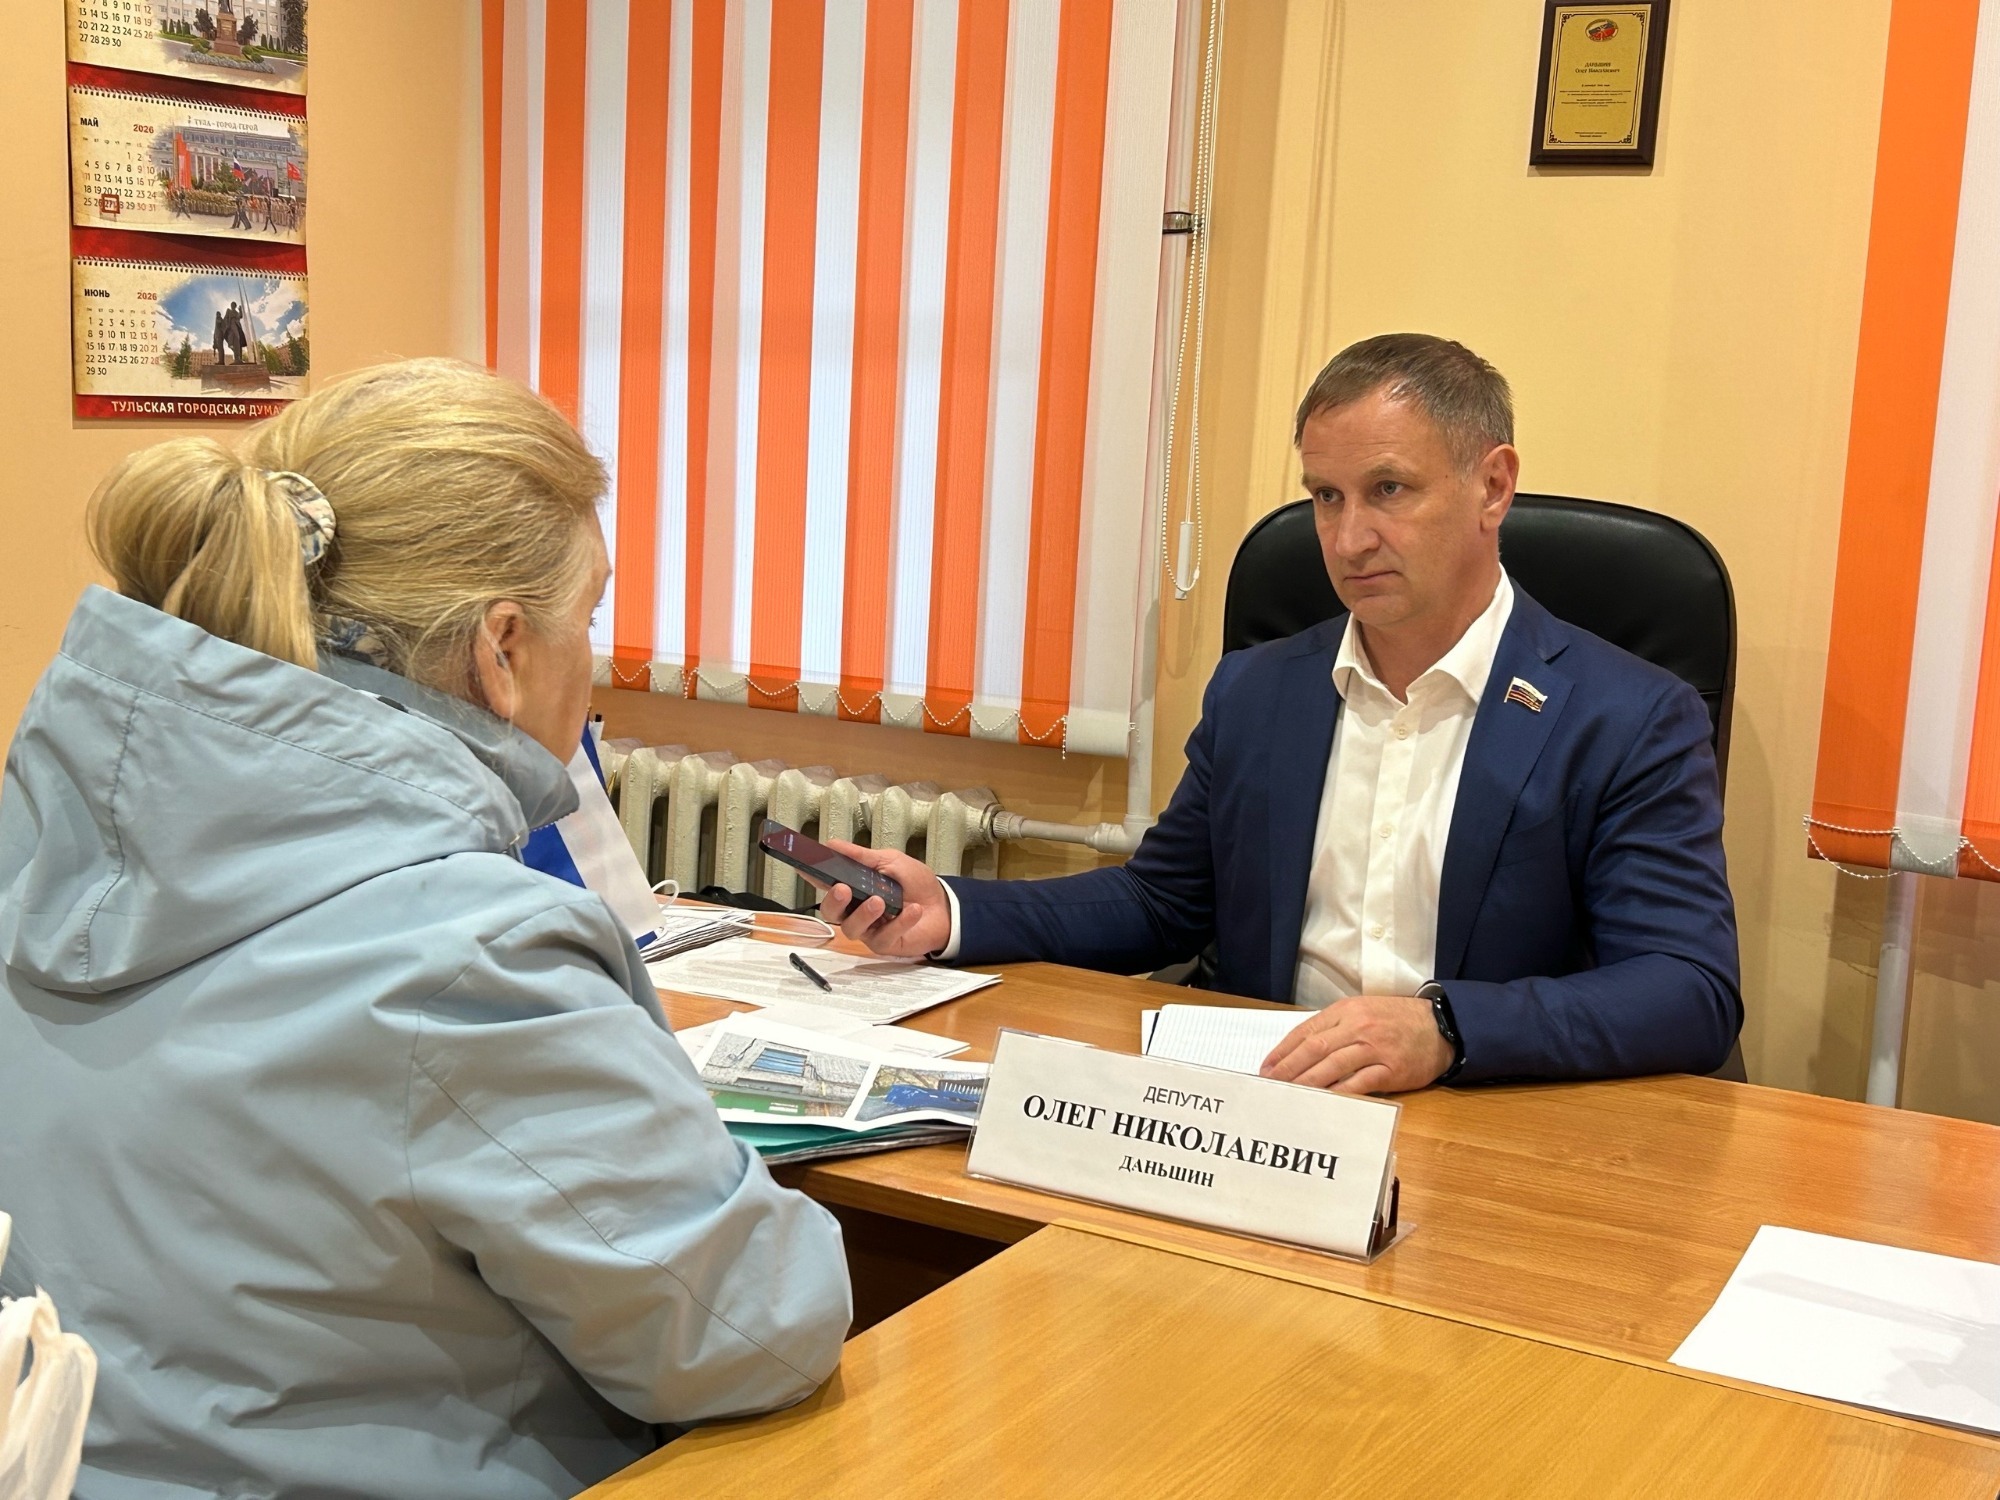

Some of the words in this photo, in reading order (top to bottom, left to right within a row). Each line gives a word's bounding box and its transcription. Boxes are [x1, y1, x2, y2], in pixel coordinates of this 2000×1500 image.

[122, 2, 131, 10] 10
[144, 6, 151, 14] 12
[79, 8, 87, 16] 13
[90, 9, 98, 18] 14
[101, 11, 108, 20] 15
[112, 13, 120, 21] 16
[124, 15, 130, 23] 17
[78, 20, 88, 29] 20
[90, 22, 98, 30] 21
[100, 24, 109, 32] 22
[112, 25, 121, 34] 23
[122, 27, 132, 36] 24
[134, 29, 142, 38] 25
[144, 31, 153, 39] 26
[80, 33, 88, 42] 27
[90, 35, 100, 44] 28
[101, 36, 110, 45] 29
[112, 38, 121, 47] 30
[80, 117, 98, 127] МАЙ
[133, 124, 154, 133] 2026
[95, 161, 99, 169] 5
[105, 162, 110, 170] 6
[116, 163, 120, 171] 7
[127, 164, 132, 172] 8
[147, 166, 155, 174] 10
[94, 174, 101, 182] 12
[115, 176, 122, 184] 14
[126, 177, 133, 185] 15
[84, 185, 92, 193] 18
[94, 186, 101, 194] 19
[124, 189, 133, 198] 22
[136, 190, 145, 198] 23
[147, 191, 157, 199] 24
[84, 198, 92, 206] 25
[126, 202, 135, 210] 29
[84, 289, 110, 298] ИЮНЬ
[137, 292, 157, 300] 2026
[110, 319, 114, 327] 3
[98, 330, 103, 338] 9
[108, 330, 115, 338] 10
[86, 342, 94, 350] 15
[120, 343, 127, 351] 18
[86, 355, 94, 363] 22
[98, 355, 106, 363] 23
[108, 355, 117, 363] 24
[130, 356, 139, 364] 26
[86, 367, 95, 375] 29
[98, 367, 107, 375] 30
[111, 401, 174, 413] ТУЛЬСКАЯ
[178, 403, 246, 416] ГОРОДСКАЯ
[250, 404, 280, 416] ДУМА
[1143, 1086, 1224, 1114] ДЕПУТАТ
[1023, 1094, 1106, 1130] ОЛЕГ
[1110, 1111, 1339, 1180] НИКОЛАЕВИЧ
[1119, 1155, 1214, 1188] ДАНЬШИН
